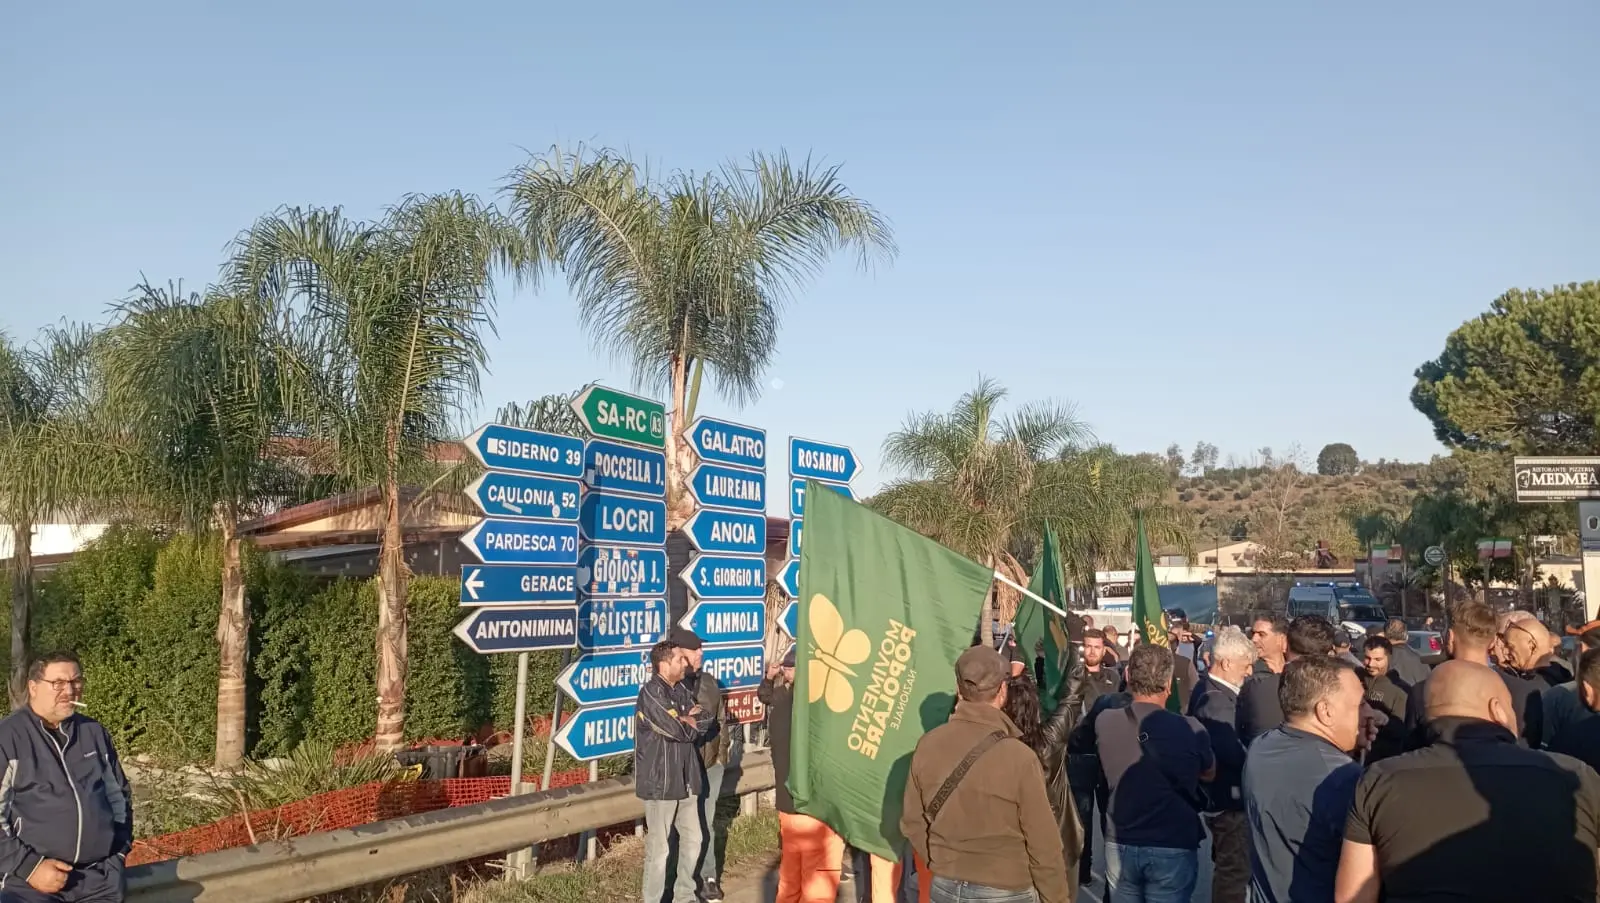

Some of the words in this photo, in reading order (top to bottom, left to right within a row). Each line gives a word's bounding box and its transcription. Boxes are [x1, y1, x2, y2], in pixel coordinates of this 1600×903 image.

[598, 400, 646, 432] SA-RC
[498, 440, 559, 462] SIDERNO
[566, 452, 580, 466] 39
[702, 429, 763, 459] GALATRO
[595, 452, 650, 484] ROCCELLA
[799, 448, 846, 473] ROSARNO
[706, 474, 761, 501] LAUREANA
[1532, 473, 1599, 486] MEDMEA
[488, 485, 554, 506] CAULONIA
[562, 494, 576, 508] 52
[602, 507, 654, 533] LOCRI
[486, 533, 556, 551] PARDESCA
[560, 536, 574, 552] 70
[711, 521, 756, 544] ANOIA
[594, 558, 645, 582] GIOIOSA
[651, 560, 660, 583] J.
[701, 568, 710, 586] S.
[714, 568, 752, 586] GIORGIO
[521, 576, 574, 592] GERACE
[475, 619, 574, 639] ANTONIMINA
[590, 610, 661, 636] POLISTENA
[706, 612, 758, 634] MAMMOLA
[703, 656, 762, 680] GIFFONE
[725, 698, 738, 708] me
[743, 694, 750, 705] di
